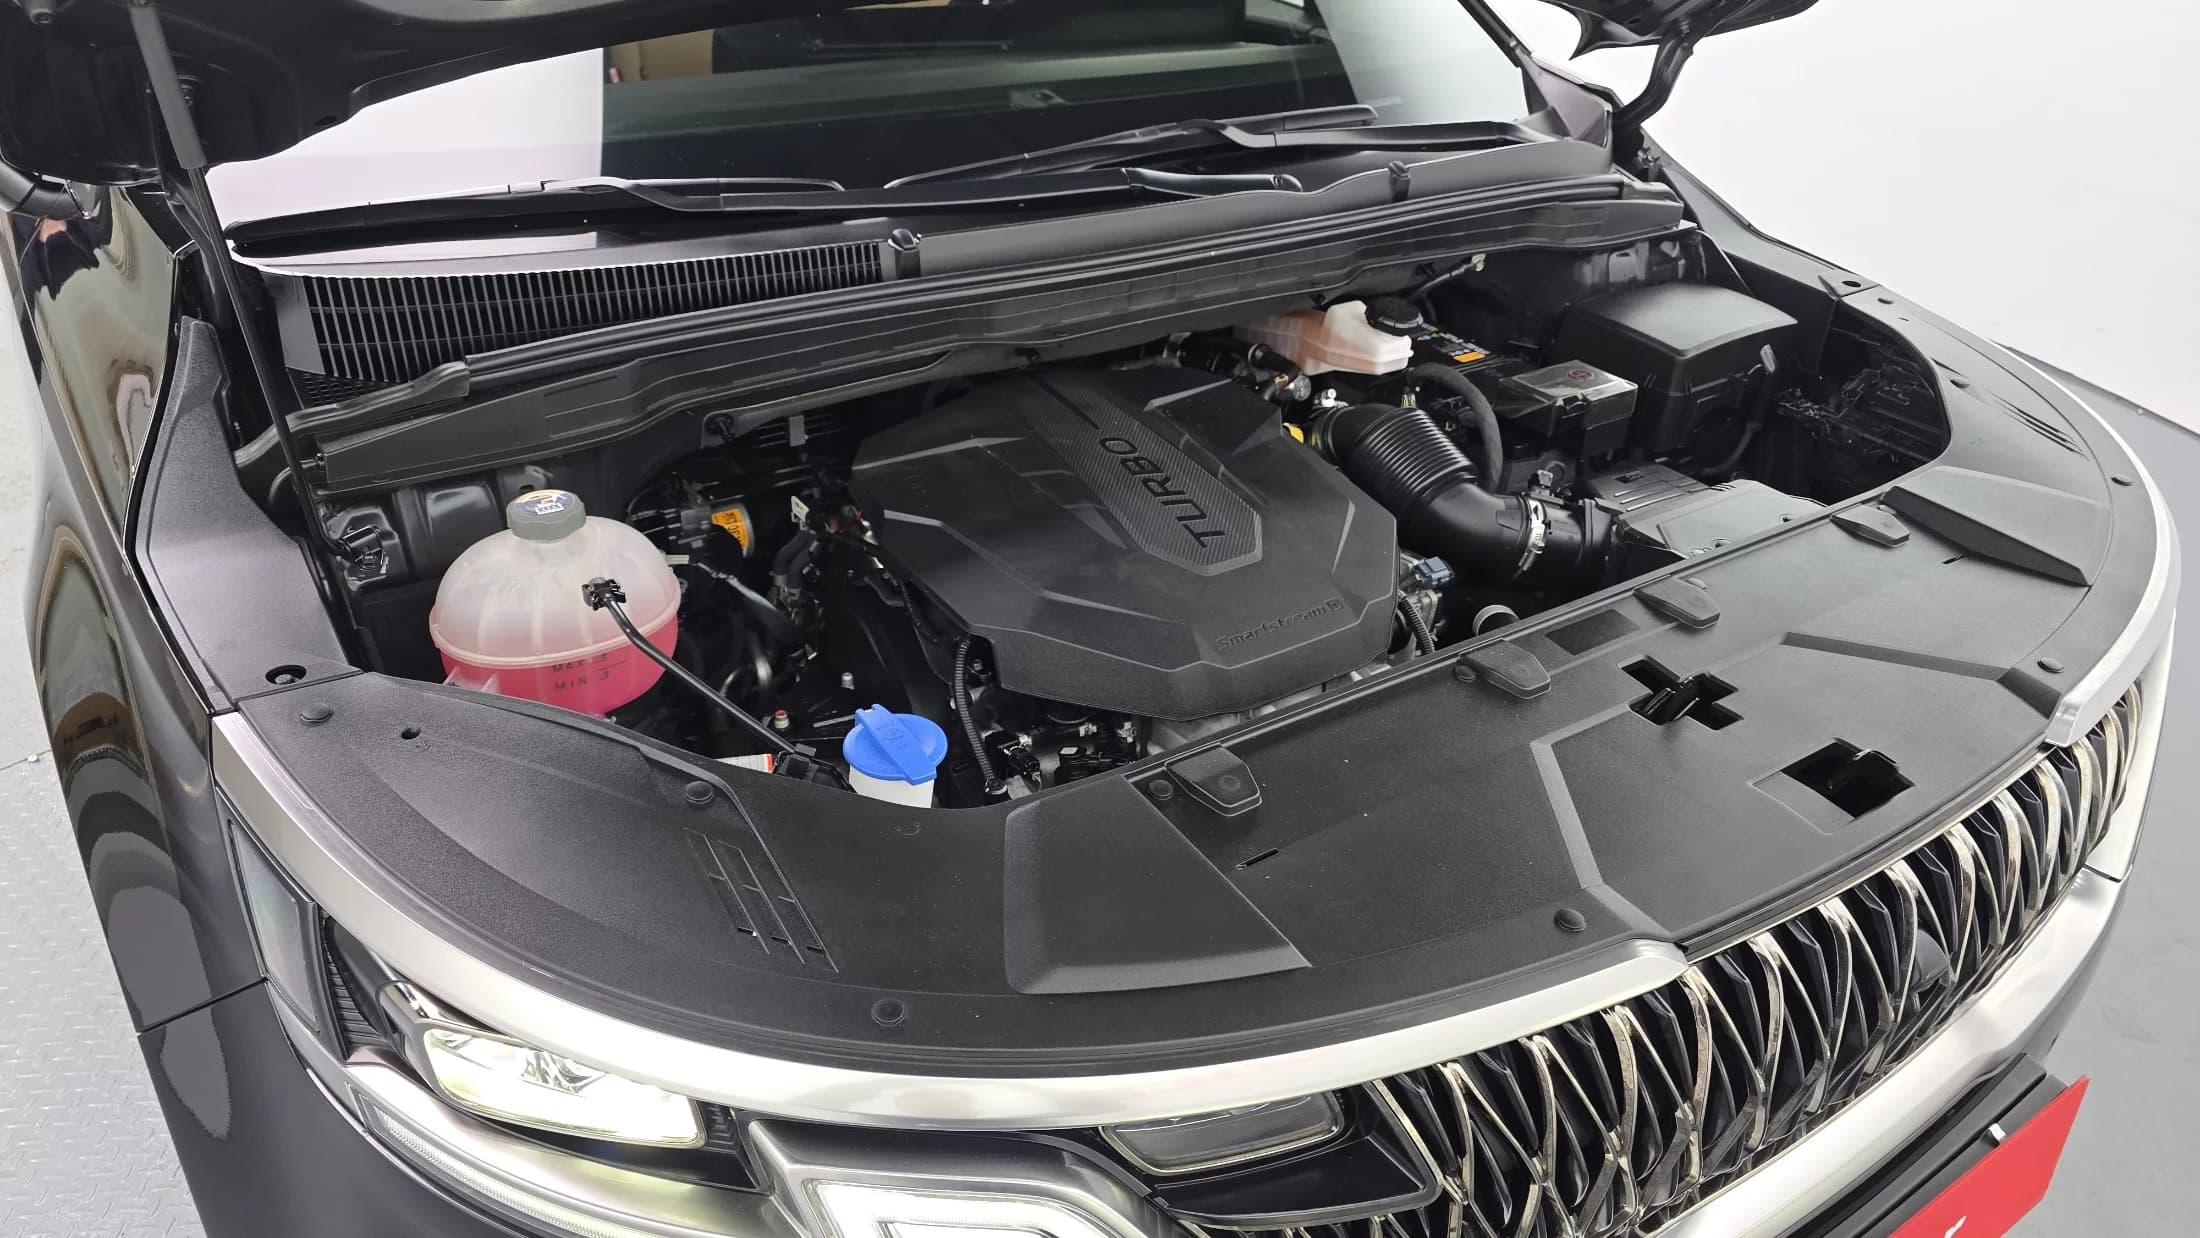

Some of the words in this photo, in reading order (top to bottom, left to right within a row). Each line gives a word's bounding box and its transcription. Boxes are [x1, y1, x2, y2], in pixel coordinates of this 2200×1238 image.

[1100, 437, 1225, 547] TURBO
[1217, 605, 1327, 650] Smartstream
[552, 658, 585, 673] MAX
[554, 676, 587, 690] MIN
